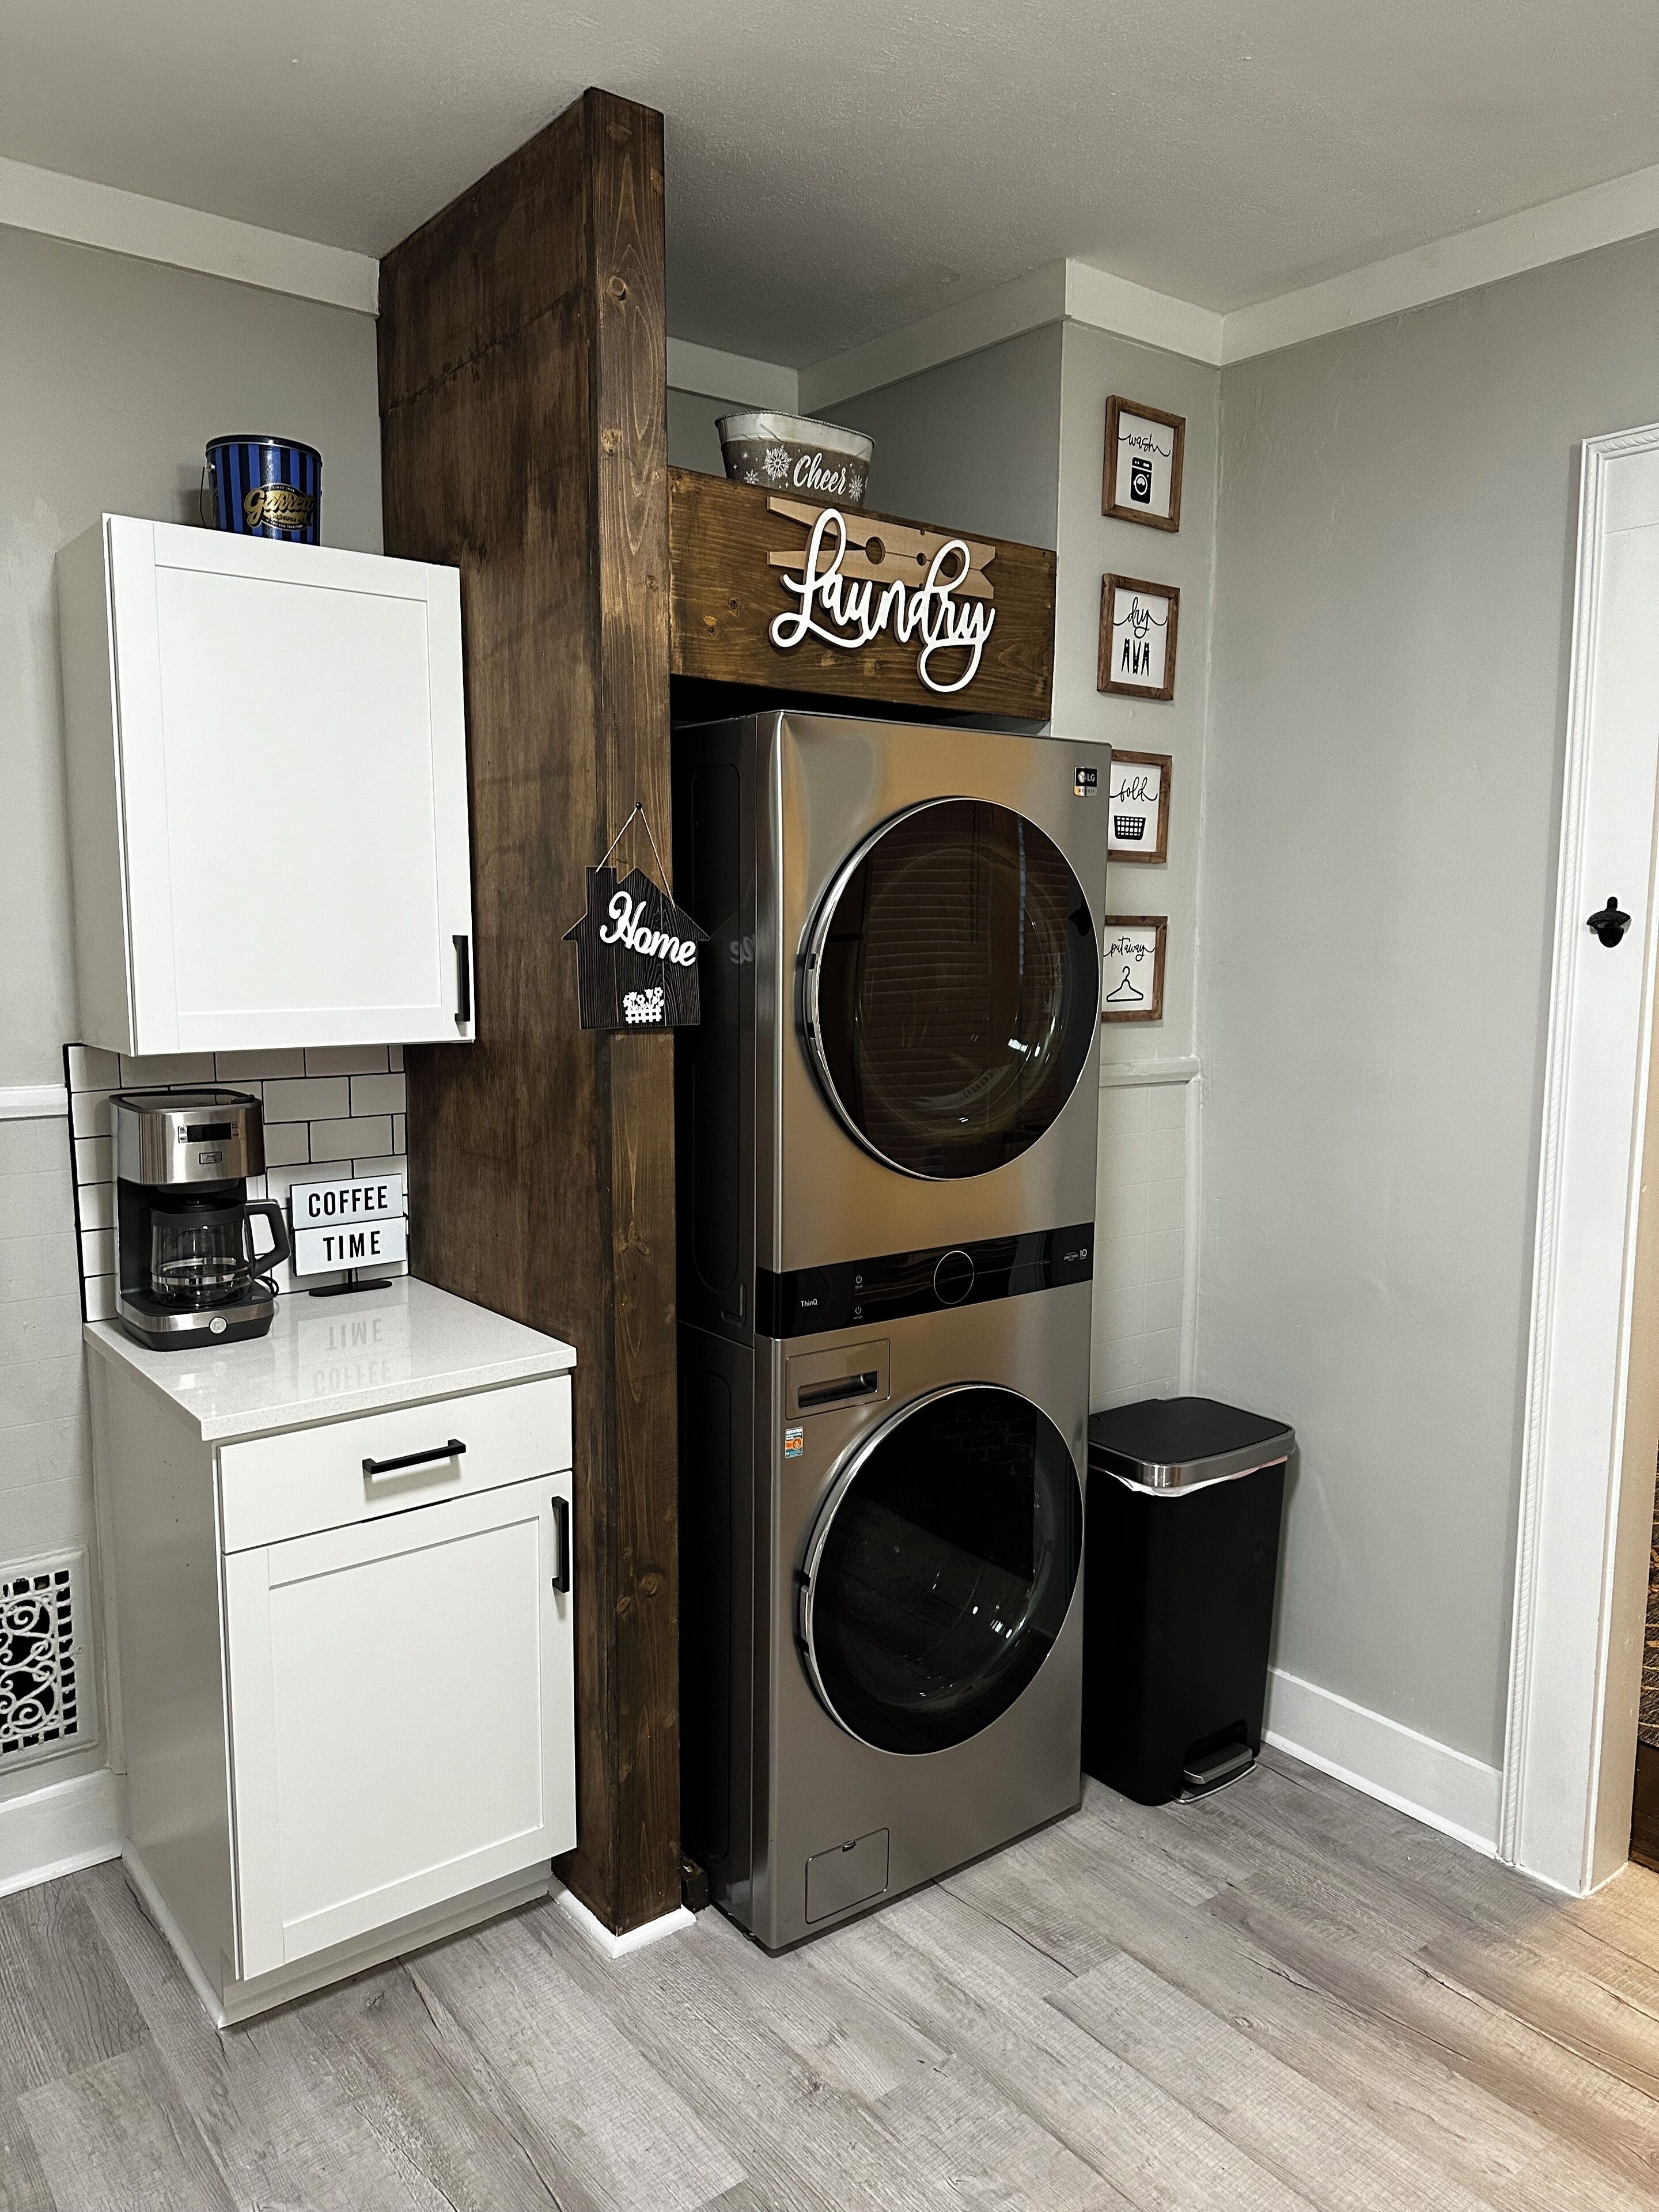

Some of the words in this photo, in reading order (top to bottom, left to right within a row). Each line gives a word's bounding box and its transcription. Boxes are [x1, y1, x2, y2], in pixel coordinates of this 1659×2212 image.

[793, 452, 847, 495] Cheer
[772, 508, 995, 692] Laundry
[1113, 597, 1168, 639] dry
[1109, 777, 1158, 802] fold
[600, 891, 696, 967] Home
[308, 1185, 388, 1218] COFFEE
[323, 1230, 381, 1262] TIME
[800, 1298, 818, 1307] ThinQ
